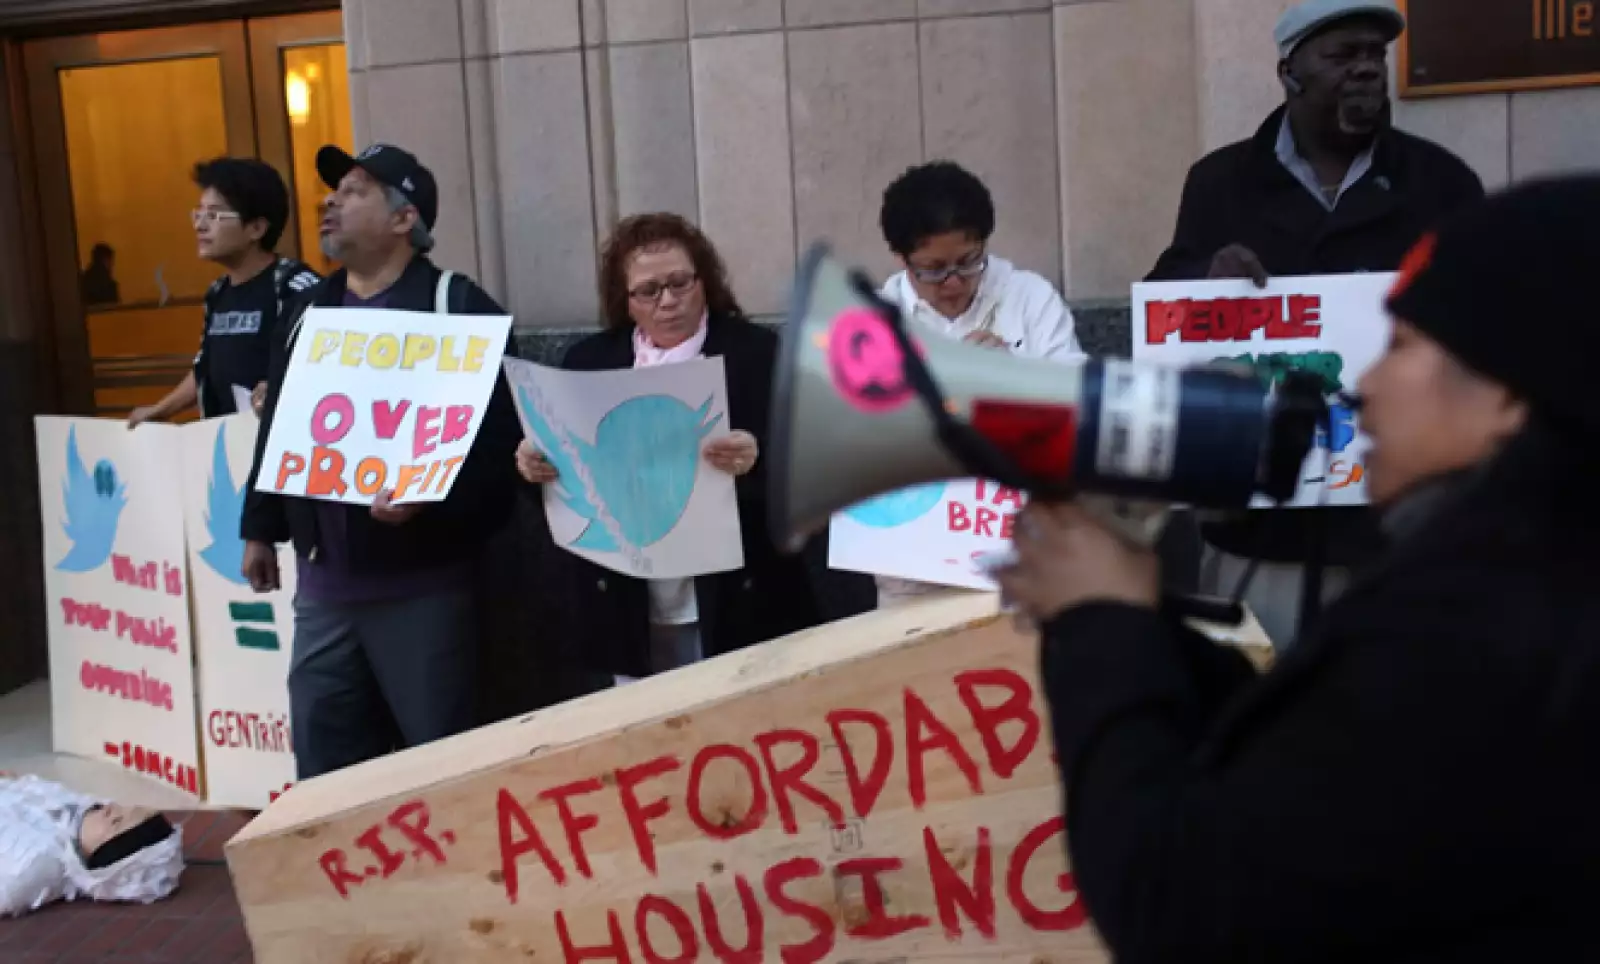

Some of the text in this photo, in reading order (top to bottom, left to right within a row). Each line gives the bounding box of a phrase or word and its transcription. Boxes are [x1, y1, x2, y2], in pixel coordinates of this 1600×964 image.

[1144, 293, 1322, 345] PEOPLE
[307, 327, 492, 374] PEOPLE
[310, 392, 475, 460] OVER
[274, 445, 464, 501] PROFIT
[946, 499, 1017, 539] BRE
[495, 667, 1058, 905] AFFORDAB
[553, 815, 1090, 964] HOUSING
